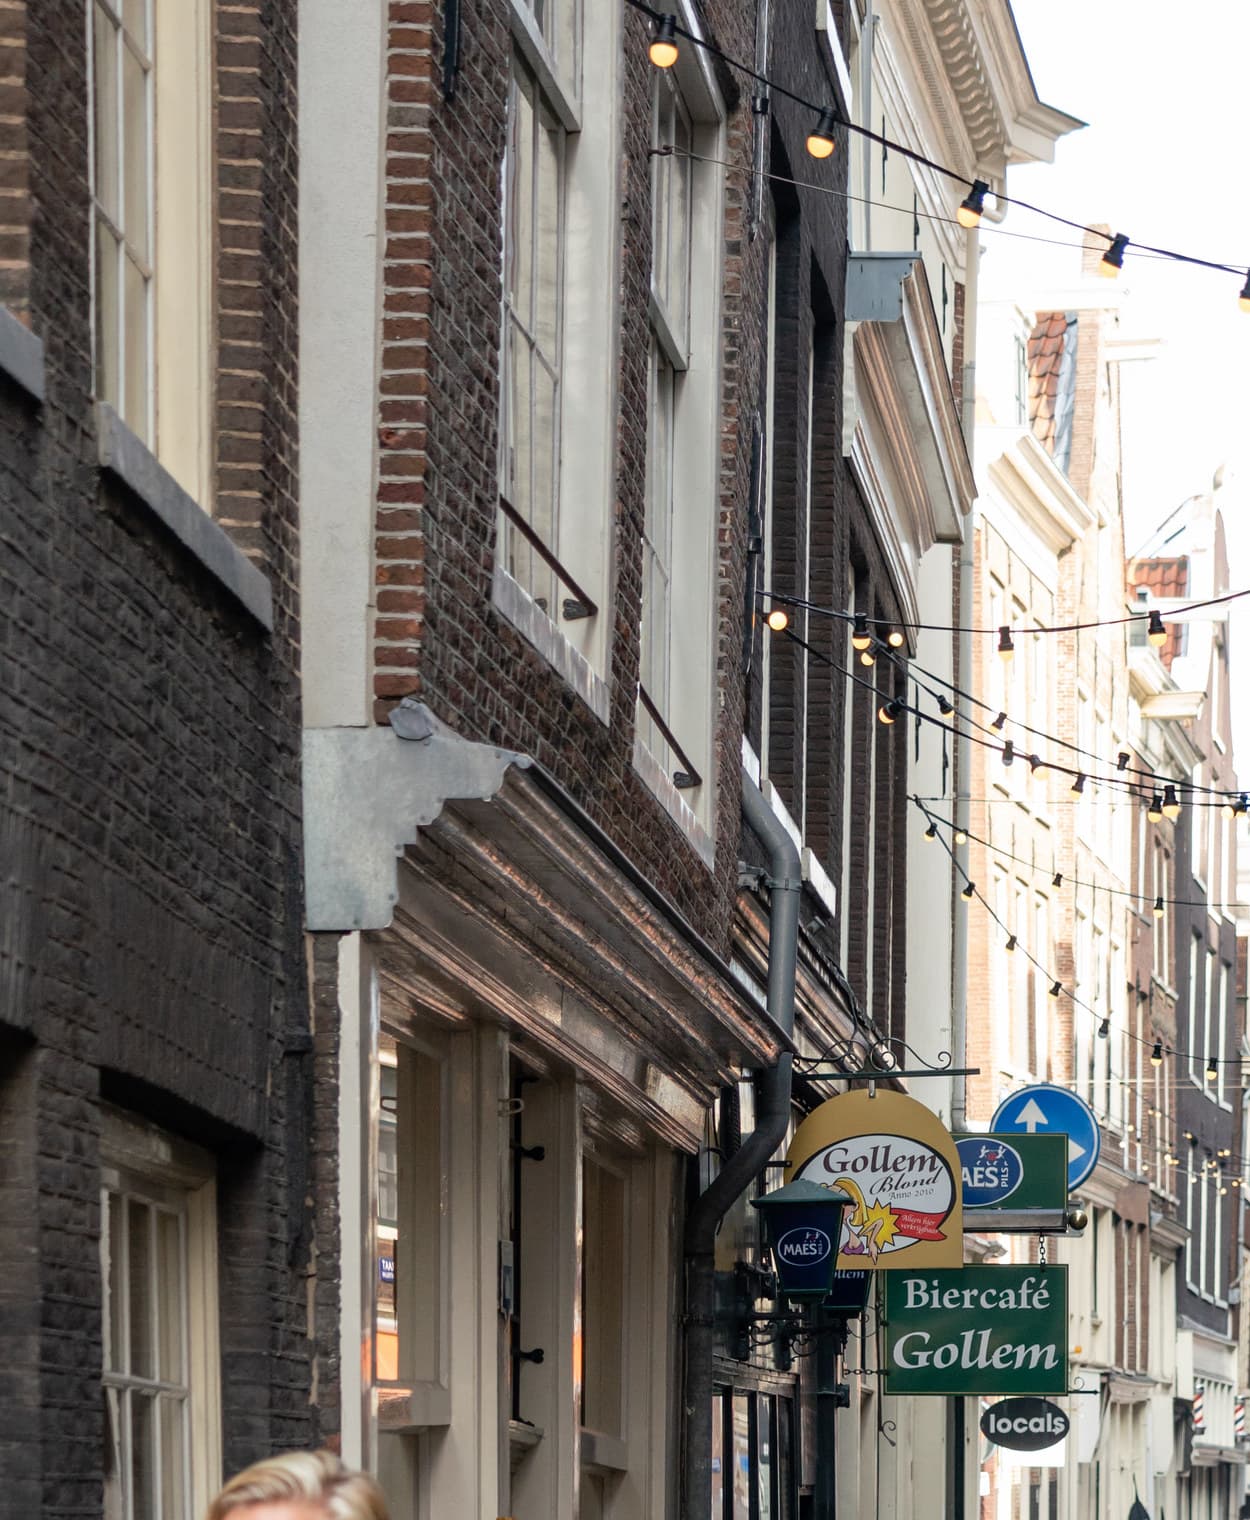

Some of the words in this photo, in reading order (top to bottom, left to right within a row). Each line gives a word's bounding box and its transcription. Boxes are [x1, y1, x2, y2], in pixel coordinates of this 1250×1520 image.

[823, 1144, 938, 1173] Gollem
[870, 1167, 943, 1195] Blond
[962, 1166, 999, 1188] AES
[1001, 1167, 1009, 1188] PILS
[889, 1191, 911, 1200] Anno
[914, 1188, 934, 1197] 2010
[783, 1243, 817, 1256] MAES
[902, 1277, 1050, 1310] Biercafé
[893, 1328, 1059, 1370] Gollem
[989, 1412, 1066, 1435] locals
